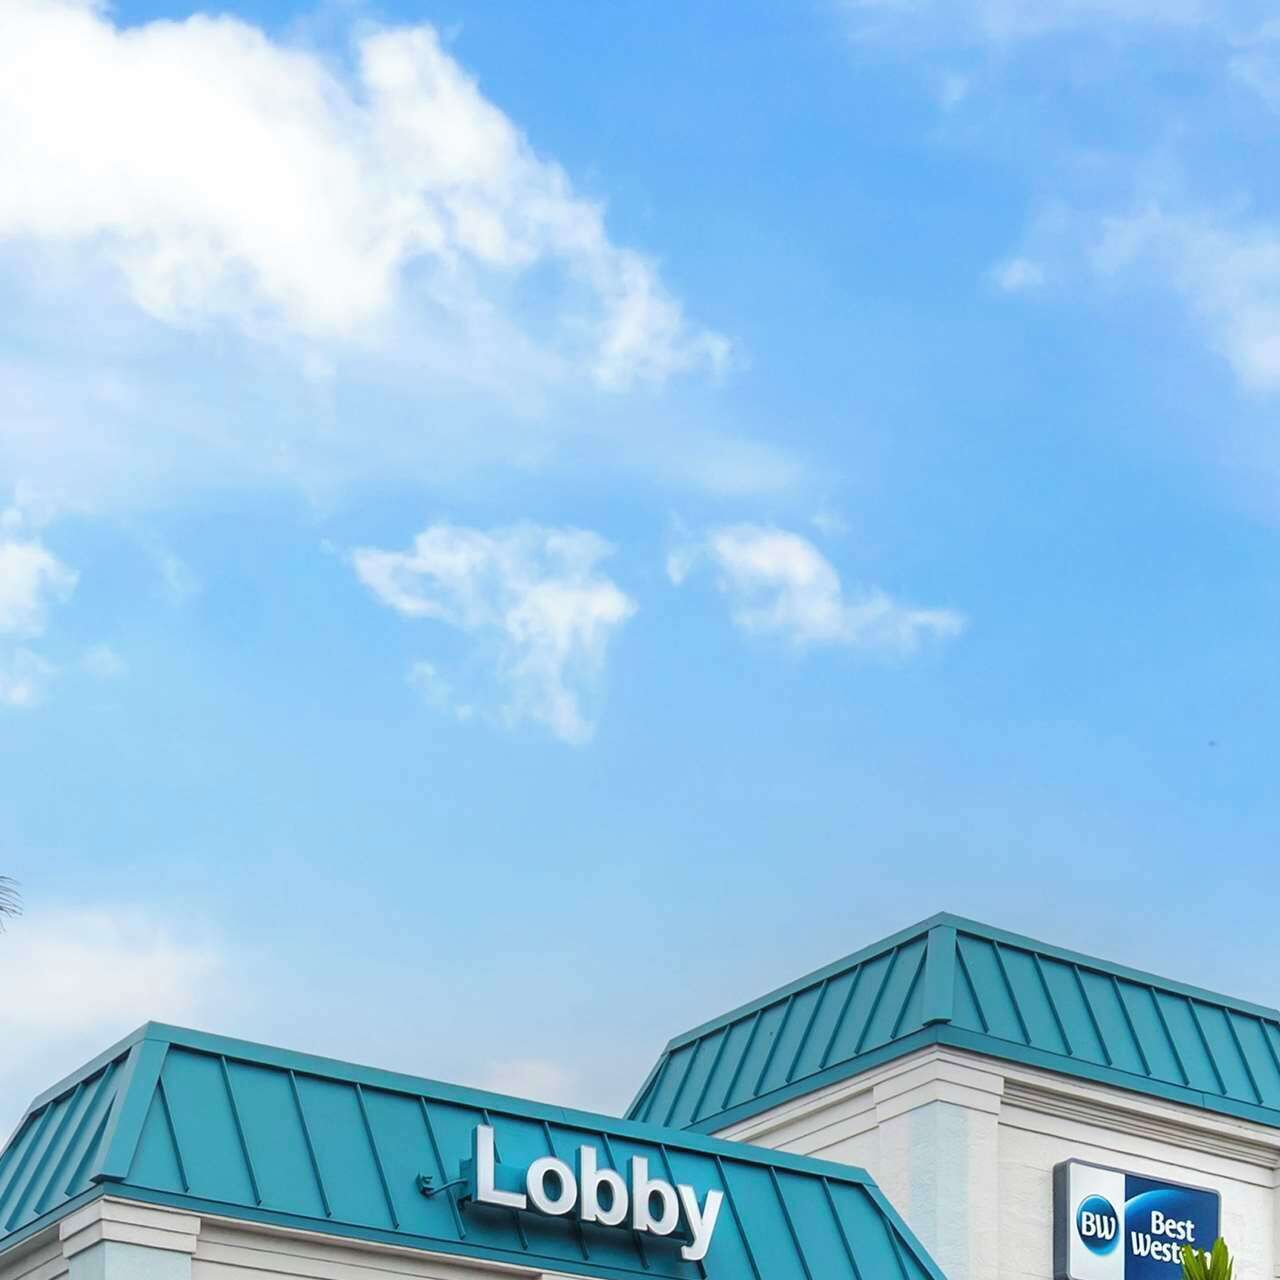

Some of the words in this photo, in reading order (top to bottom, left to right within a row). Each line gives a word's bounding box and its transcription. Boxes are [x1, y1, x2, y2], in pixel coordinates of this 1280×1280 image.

[475, 1124, 724, 1261] Lobby
[1081, 1211, 1116, 1240] BW
[1151, 1210, 1195, 1242] Best
